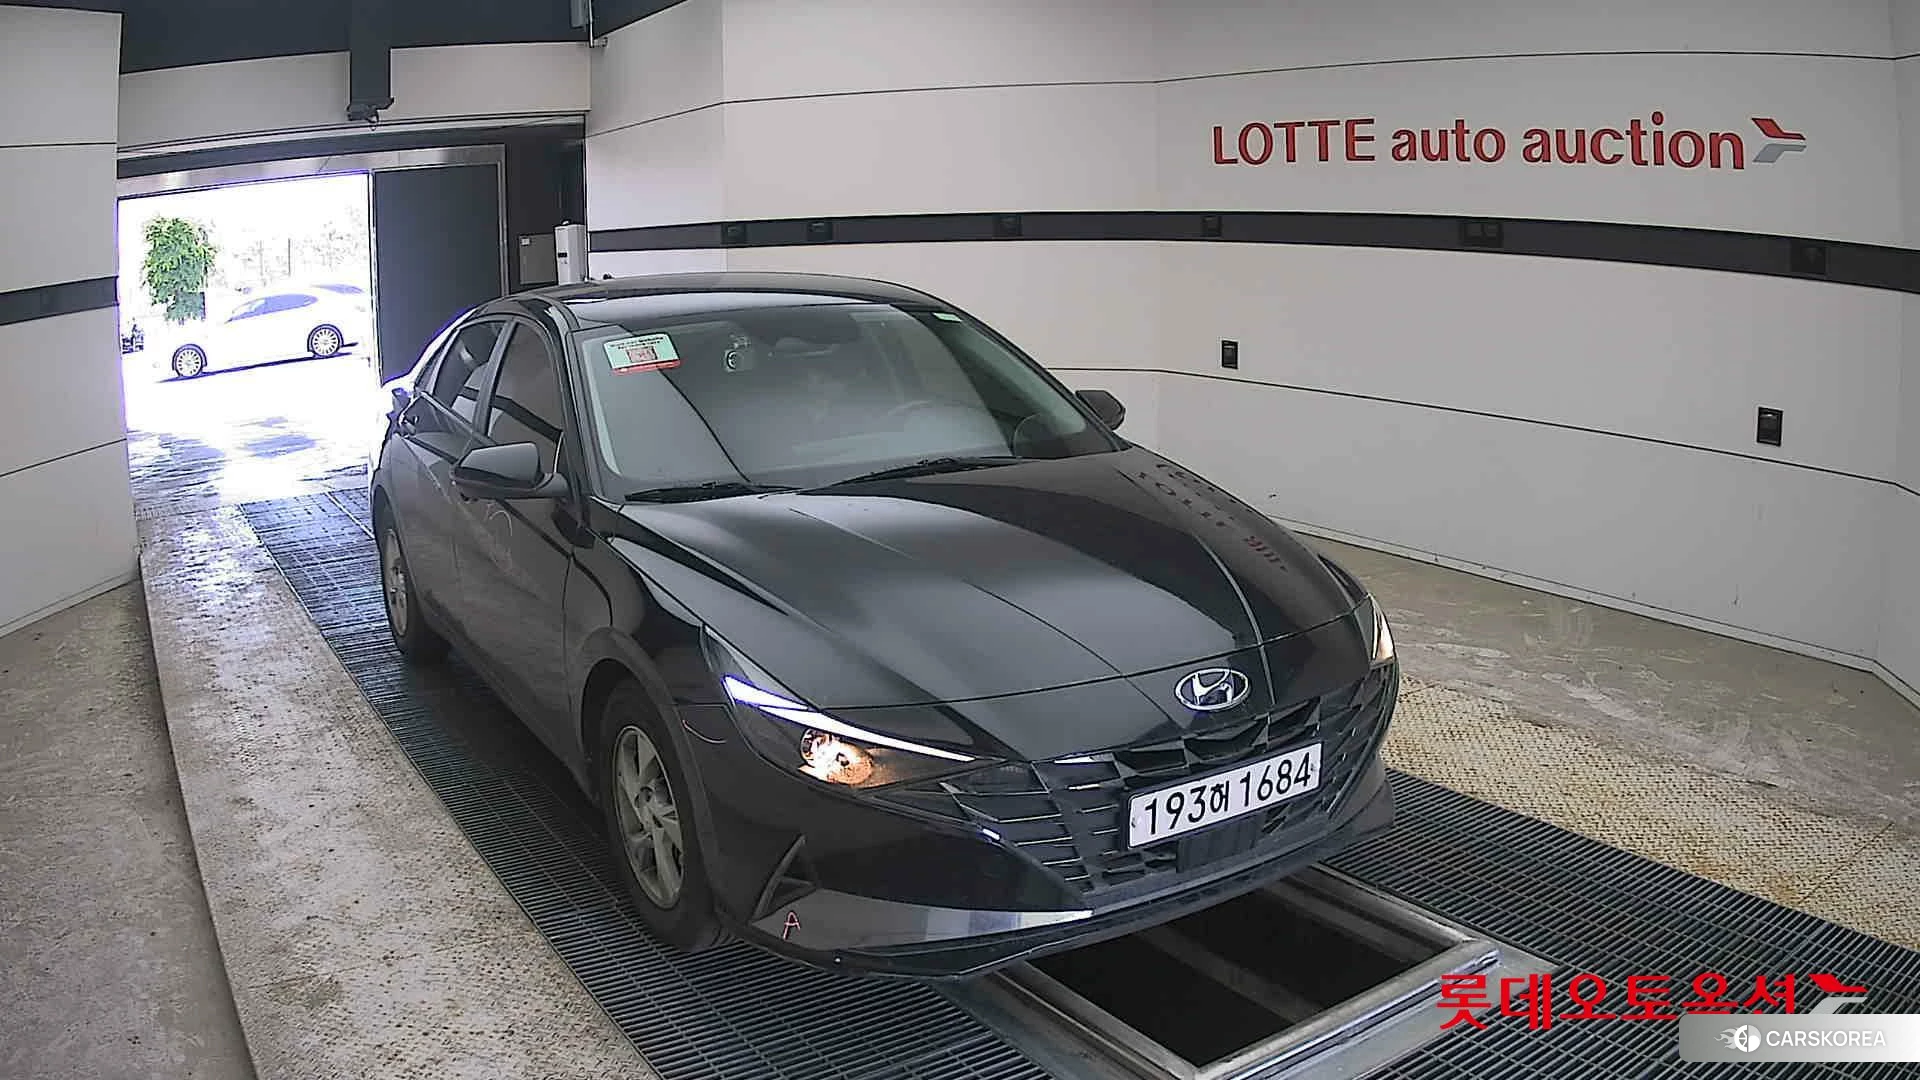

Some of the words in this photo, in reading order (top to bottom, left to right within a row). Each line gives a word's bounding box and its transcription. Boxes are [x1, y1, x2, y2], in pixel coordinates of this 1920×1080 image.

[1212, 118, 1376, 165] LOTTE
[1391, 118, 1506, 162] auto
[1522, 111, 1745, 170] auction
[1144, 780, 1231, 835] 193허
[1239, 752, 1312, 807] 1684
